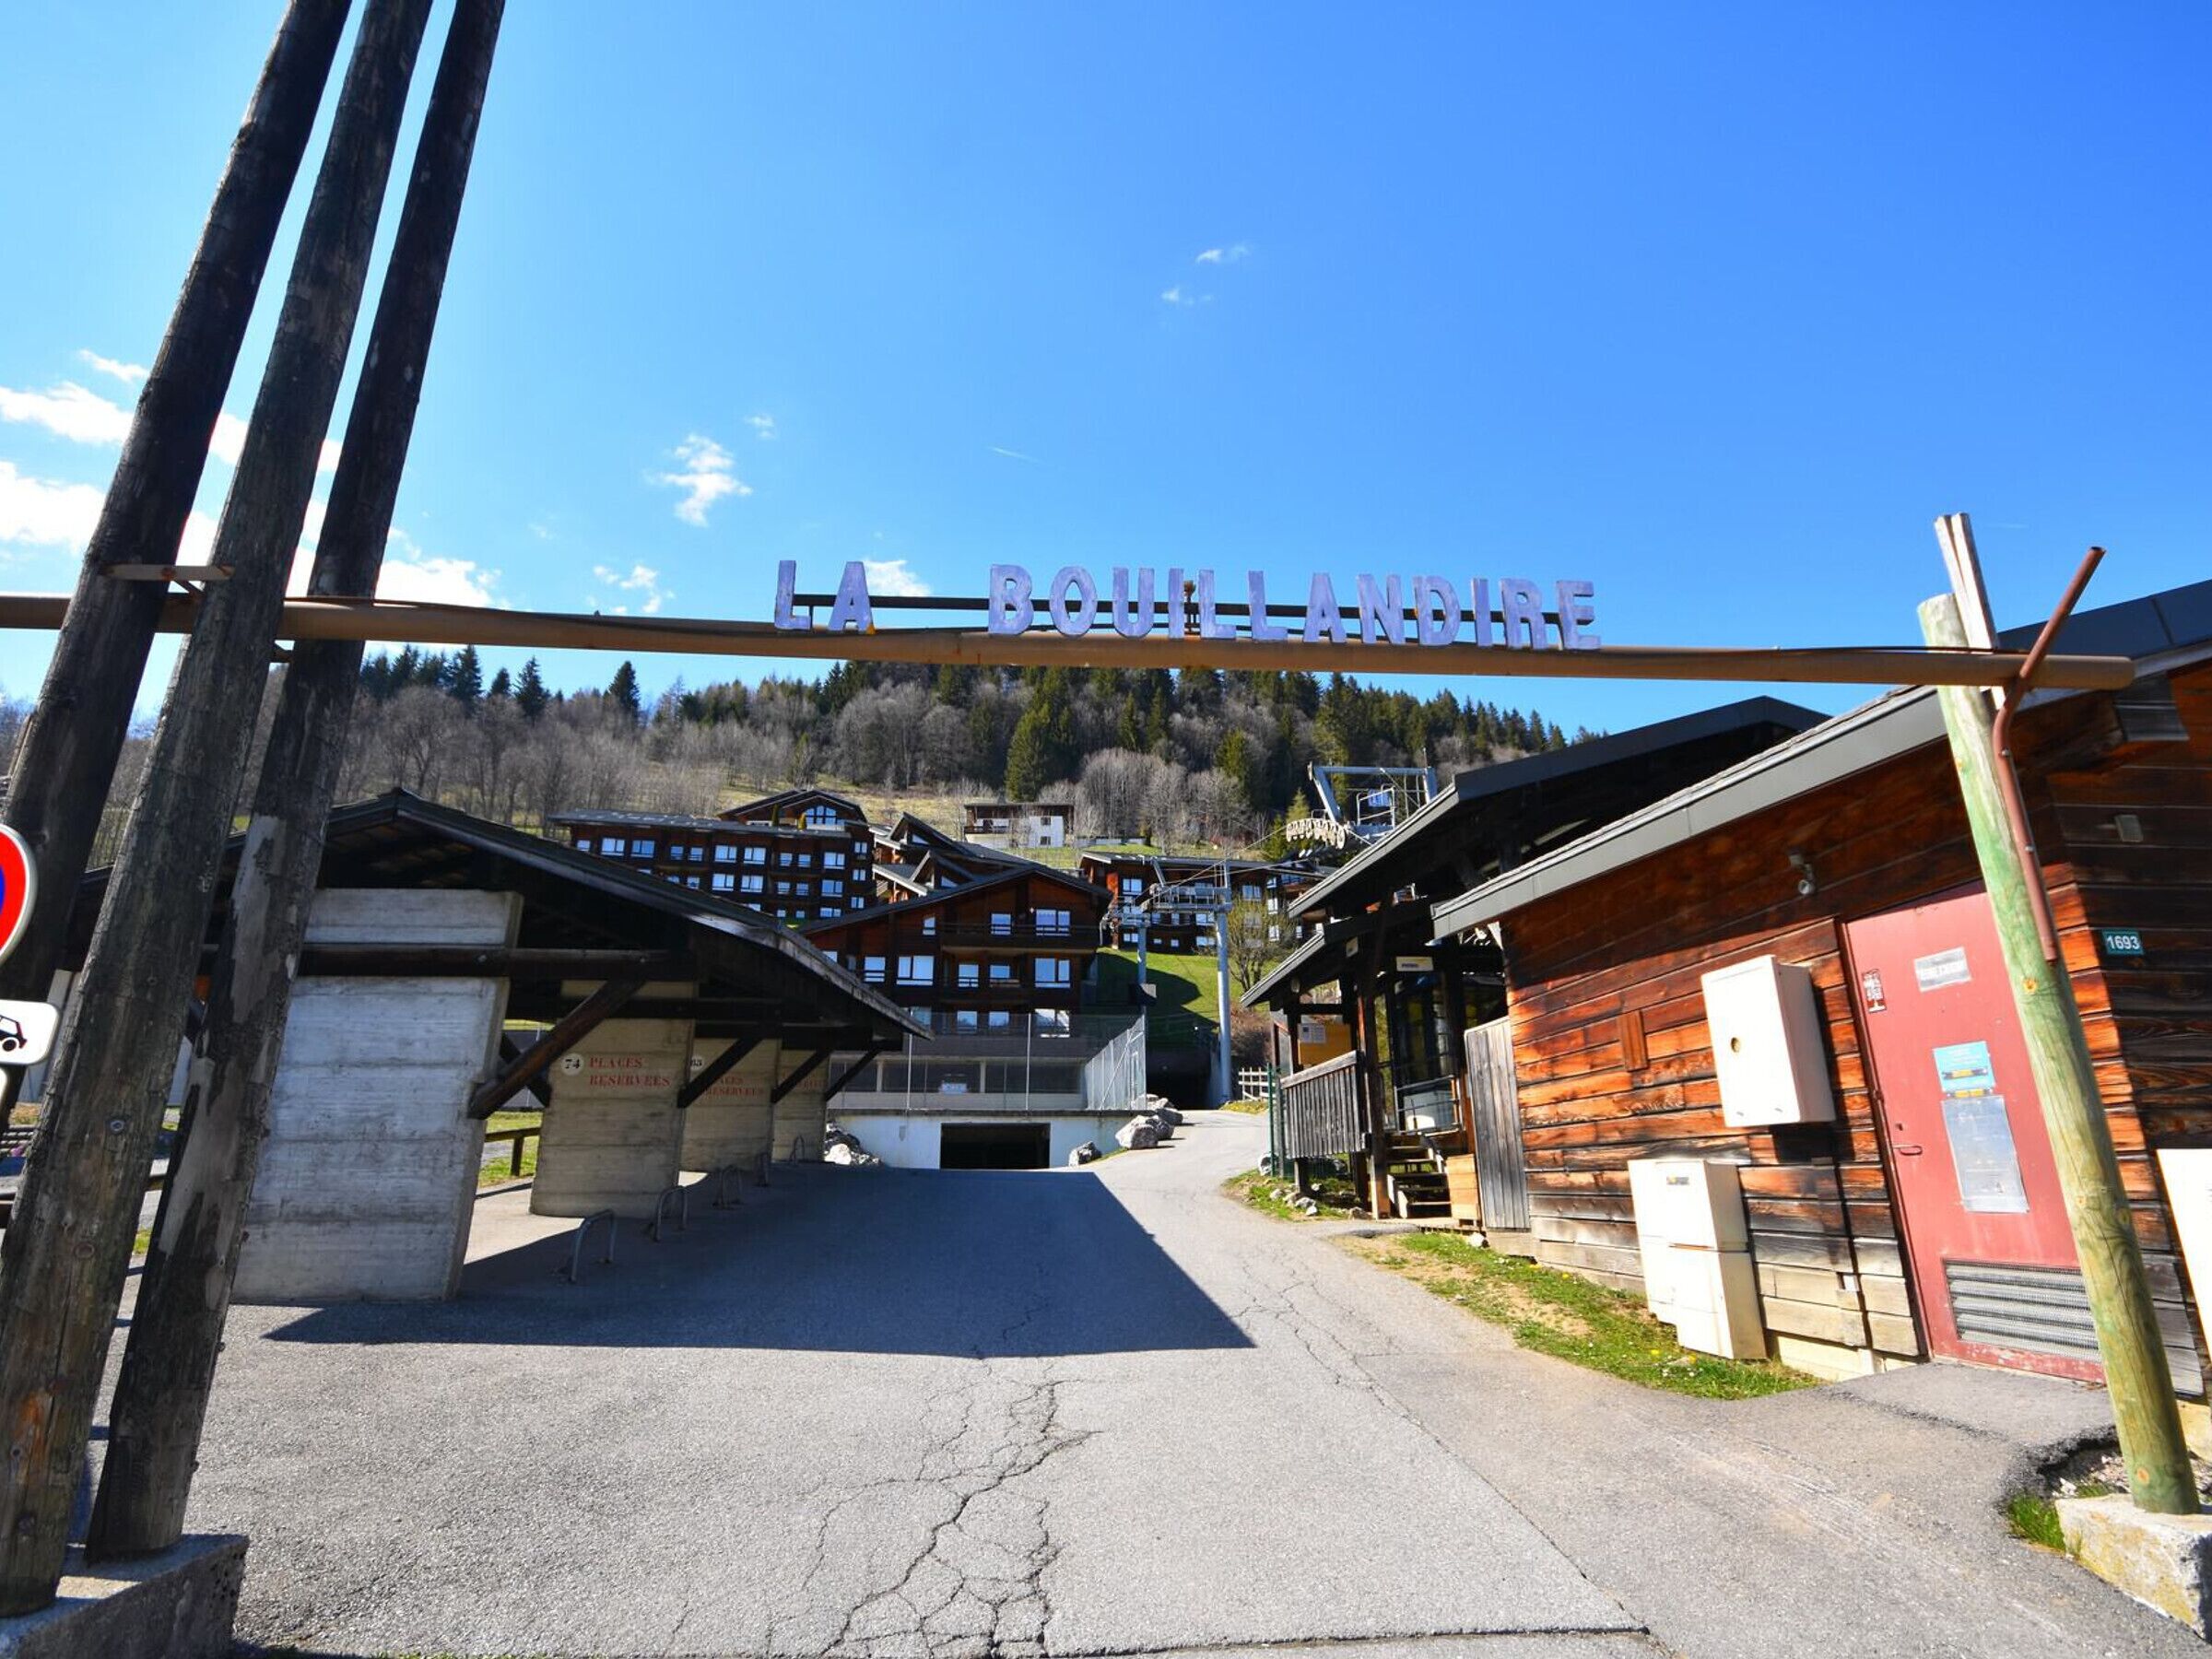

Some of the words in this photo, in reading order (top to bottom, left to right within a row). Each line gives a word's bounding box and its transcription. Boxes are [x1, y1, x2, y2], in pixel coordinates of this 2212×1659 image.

[774, 559, 875, 634] LA
[988, 563, 1602, 651] BOUILLANDIRE
[2107, 935, 2140, 950] 1693
[564, 1058, 581, 1069] 74
[589, 1056, 643, 1068] PLACES
